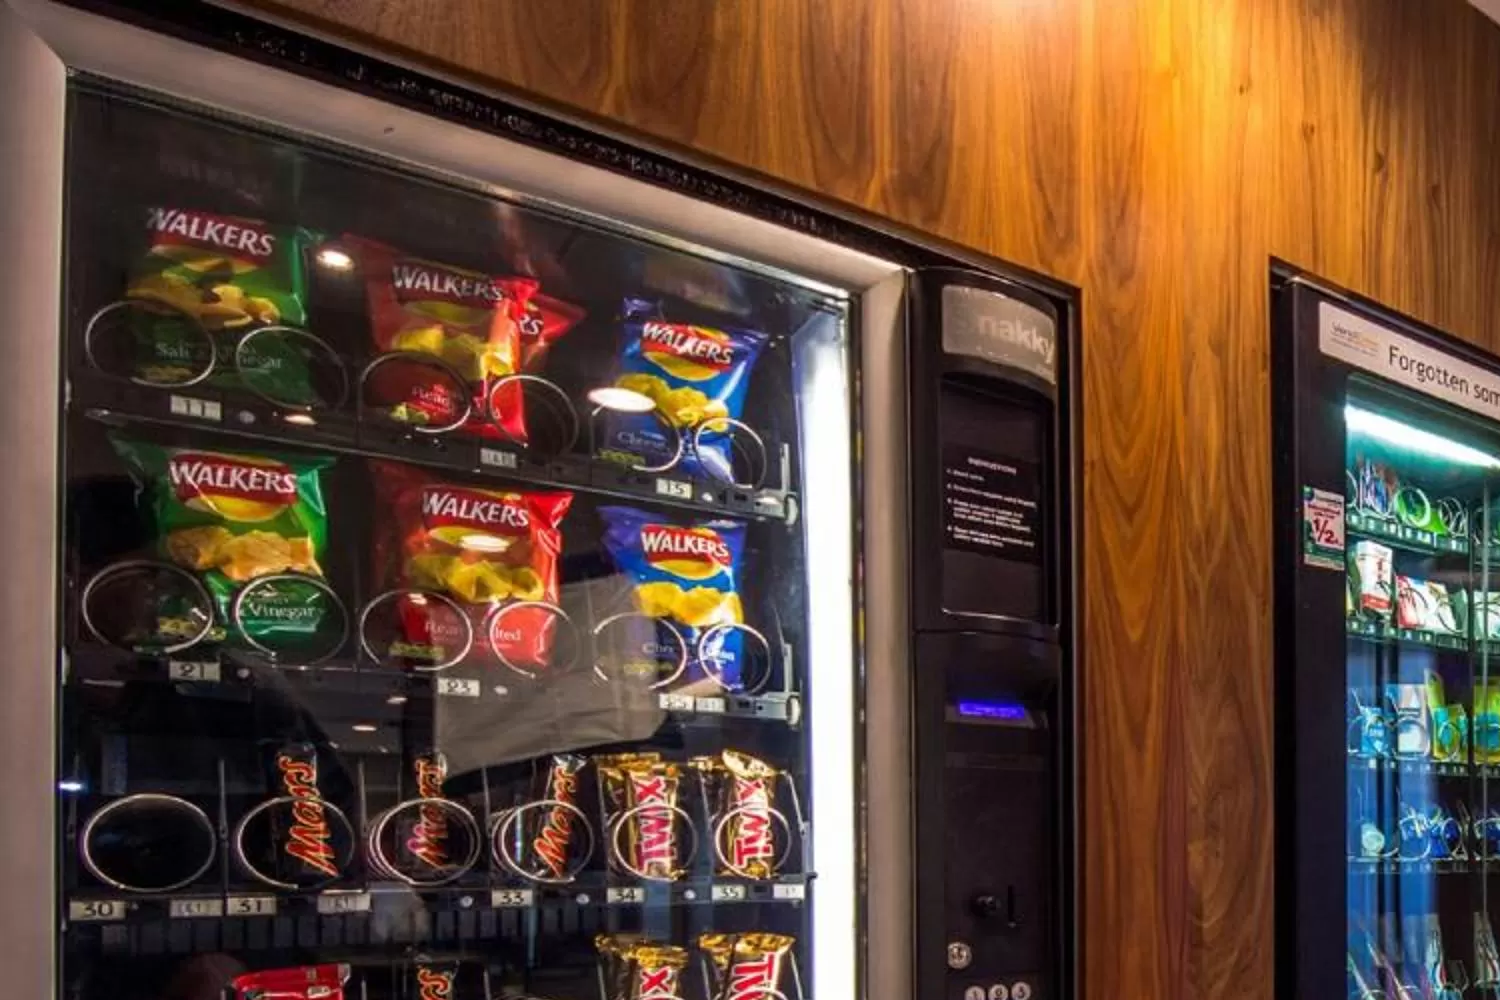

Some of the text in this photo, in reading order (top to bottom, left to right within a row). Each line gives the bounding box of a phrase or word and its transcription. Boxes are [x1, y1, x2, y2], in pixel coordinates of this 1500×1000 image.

[148, 207, 275, 255] WALKERS
[392, 264, 504, 302] WALKERS
[643, 321, 734, 365] WALKERS
[952, 304, 1055, 365] nakky
[1388, 345, 1469, 393] Forgotten
[170, 461, 297, 494] WALKERS
[422, 491, 529, 528] WALKERS
[641, 529, 729, 558] WALKERS
[250, 603, 317, 620] Vinegar
[278, 754, 339, 877] Mars
[82, 901, 113, 918] 30
[237, 899, 262, 913] 31
[501, 892, 525, 905] 33
[615, 887, 636, 902] 34
